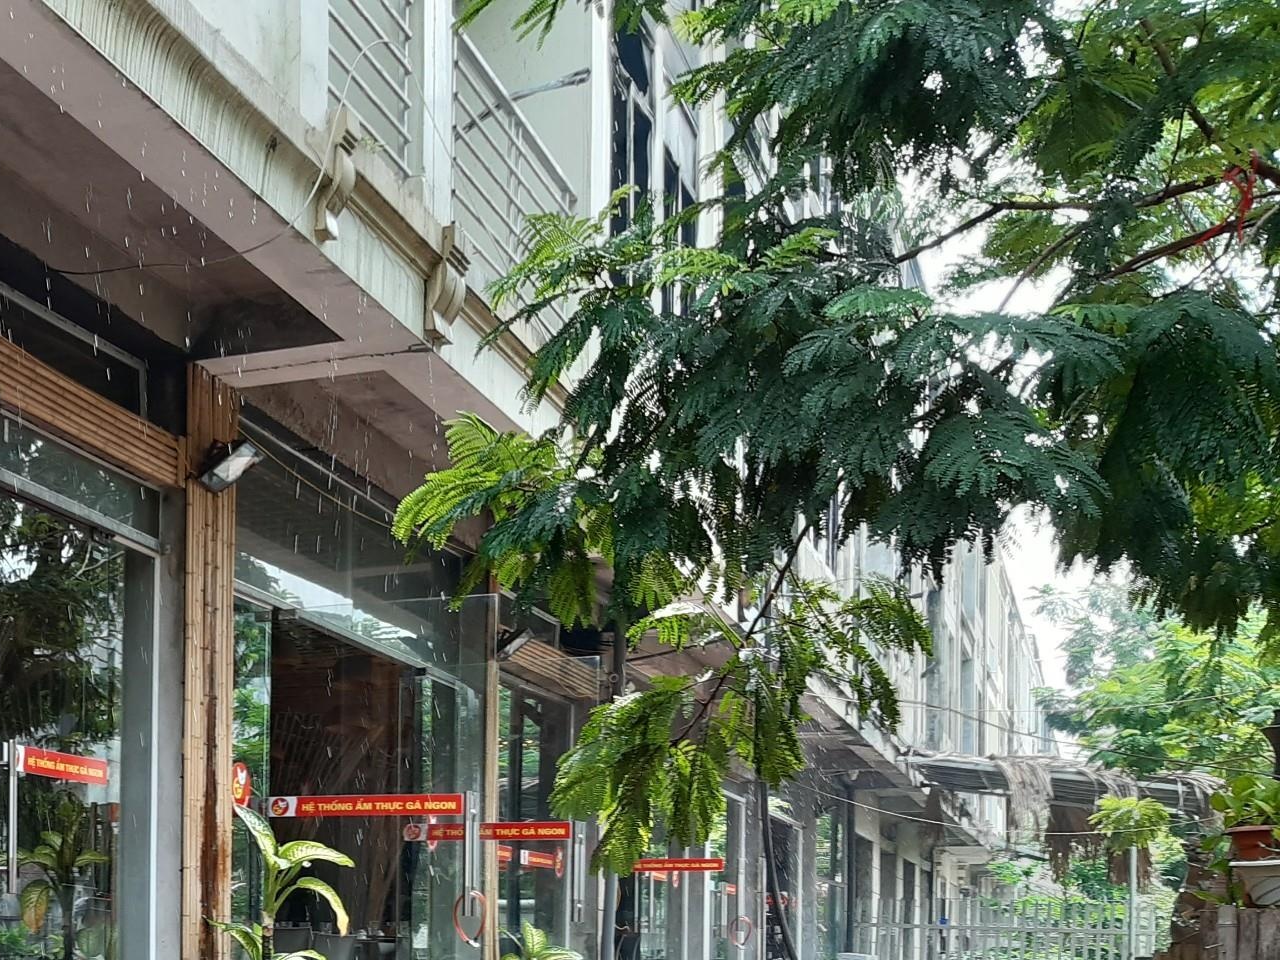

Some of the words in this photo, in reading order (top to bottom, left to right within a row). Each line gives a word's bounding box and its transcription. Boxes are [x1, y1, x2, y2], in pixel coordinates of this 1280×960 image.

[302, 801, 315, 813] HỆ
[318, 800, 353, 811] THỐNG
[374, 801, 403, 812] THỰC
[405, 800, 422, 810] GÀ
[424, 801, 456, 810] NGON
[495, 827, 520, 837] THỰC
[521, 827, 537, 836] GÀ
[538, 828, 565, 836] NGON
